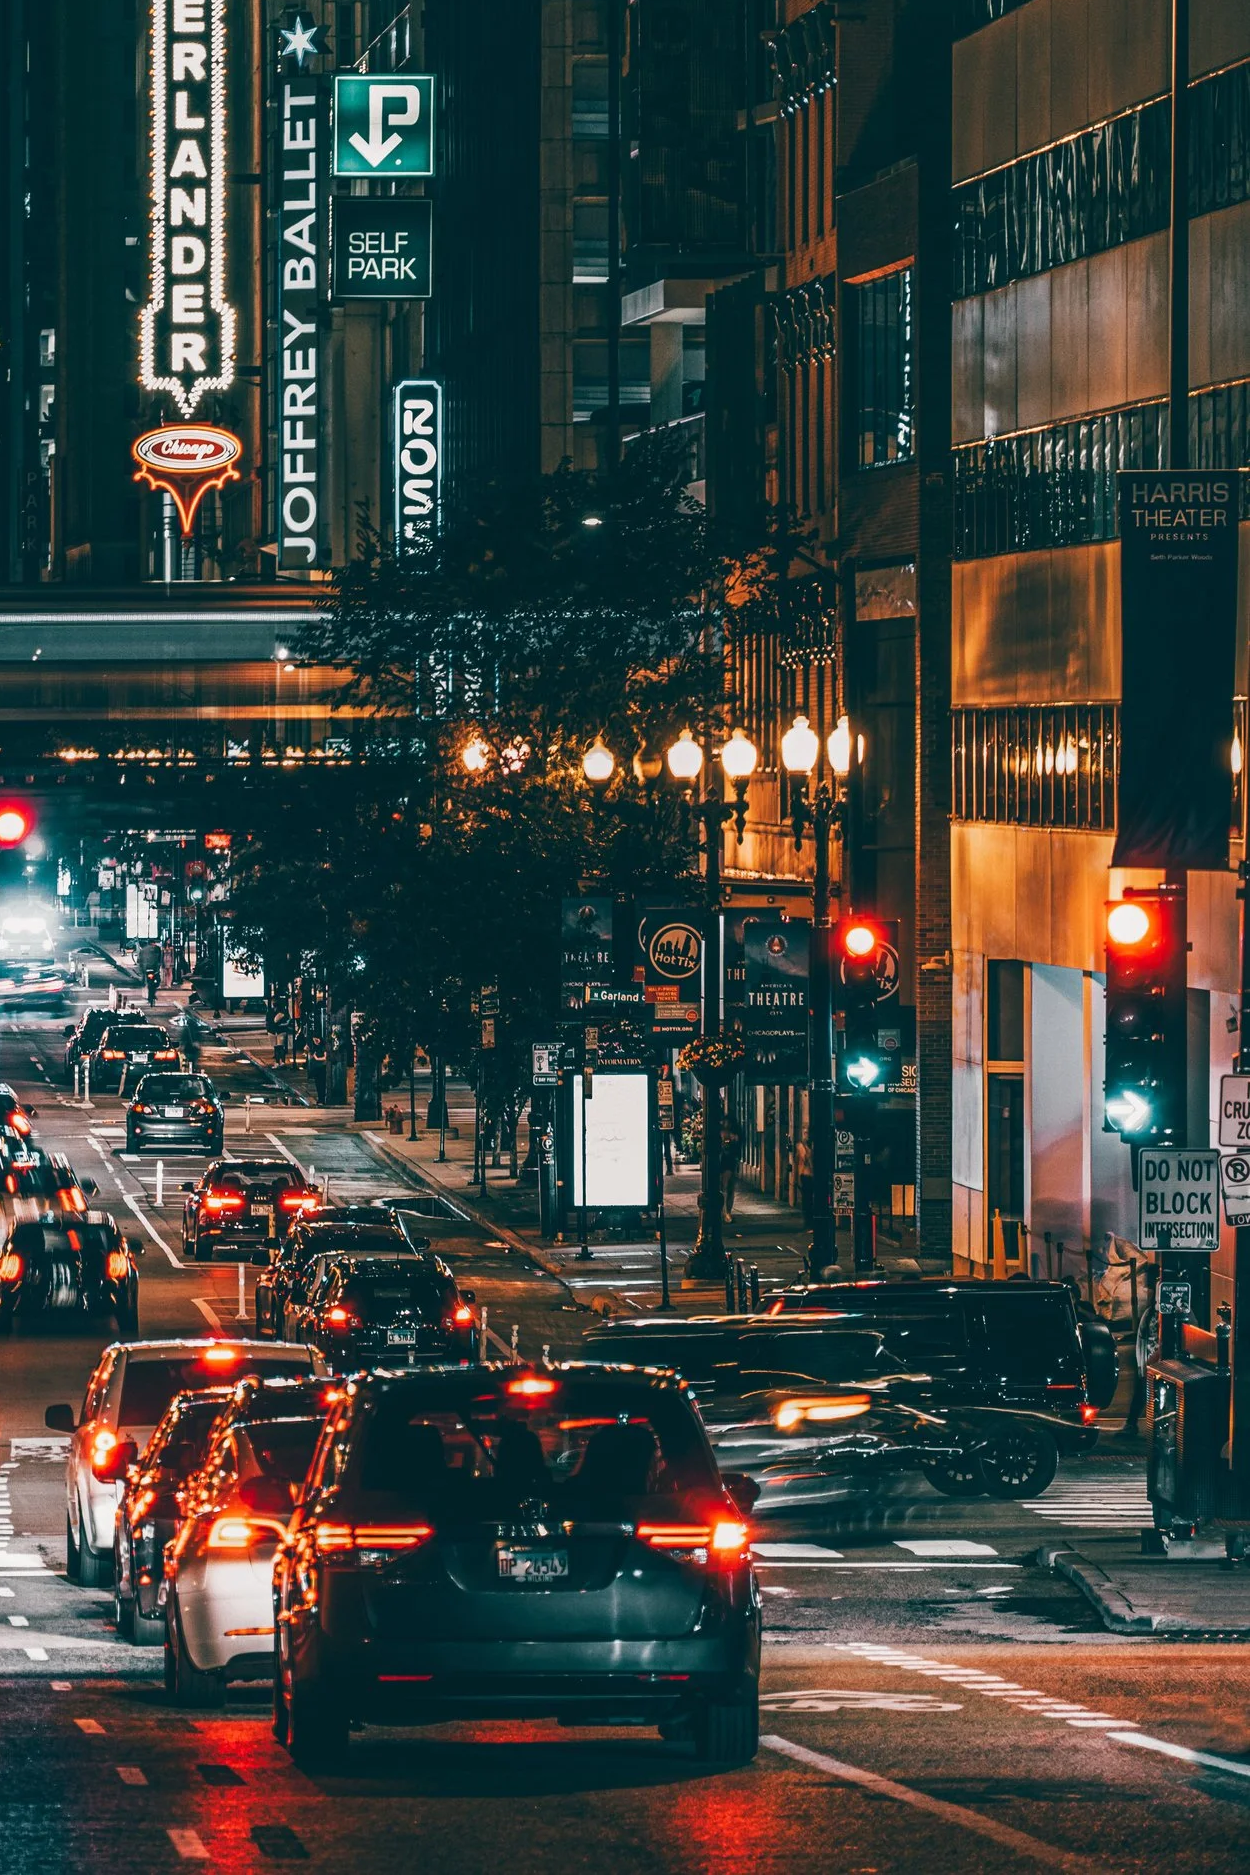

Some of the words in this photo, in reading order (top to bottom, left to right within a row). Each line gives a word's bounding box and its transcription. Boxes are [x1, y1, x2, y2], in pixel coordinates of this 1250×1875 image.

[282, 84, 319, 290] BALLET
[349, 232, 410, 256] SELF
[348, 257, 418, 281] PARK
[161, 439, 215, 461] Chicago
[282, 321, 319, 566] JOFFREY
[1132, 482, 1230, 504] HARRIS
[1131, 509, 1227, 527] THEATER
[1150, 533, 1209, 541] PRESENTS
[601, 990, 639, 1002] Garland
[748, 992, 804, 1006] THEATRE
[597, 1058, 642, 1066] INFORMATION
[1144, 1159, 1170, 1182] DO
[1177, 1159, 1214, 1182] NOT
[1145, 1192, 1212, 1215] BLOCK
[524, 1558, 567, 1575] 24549
